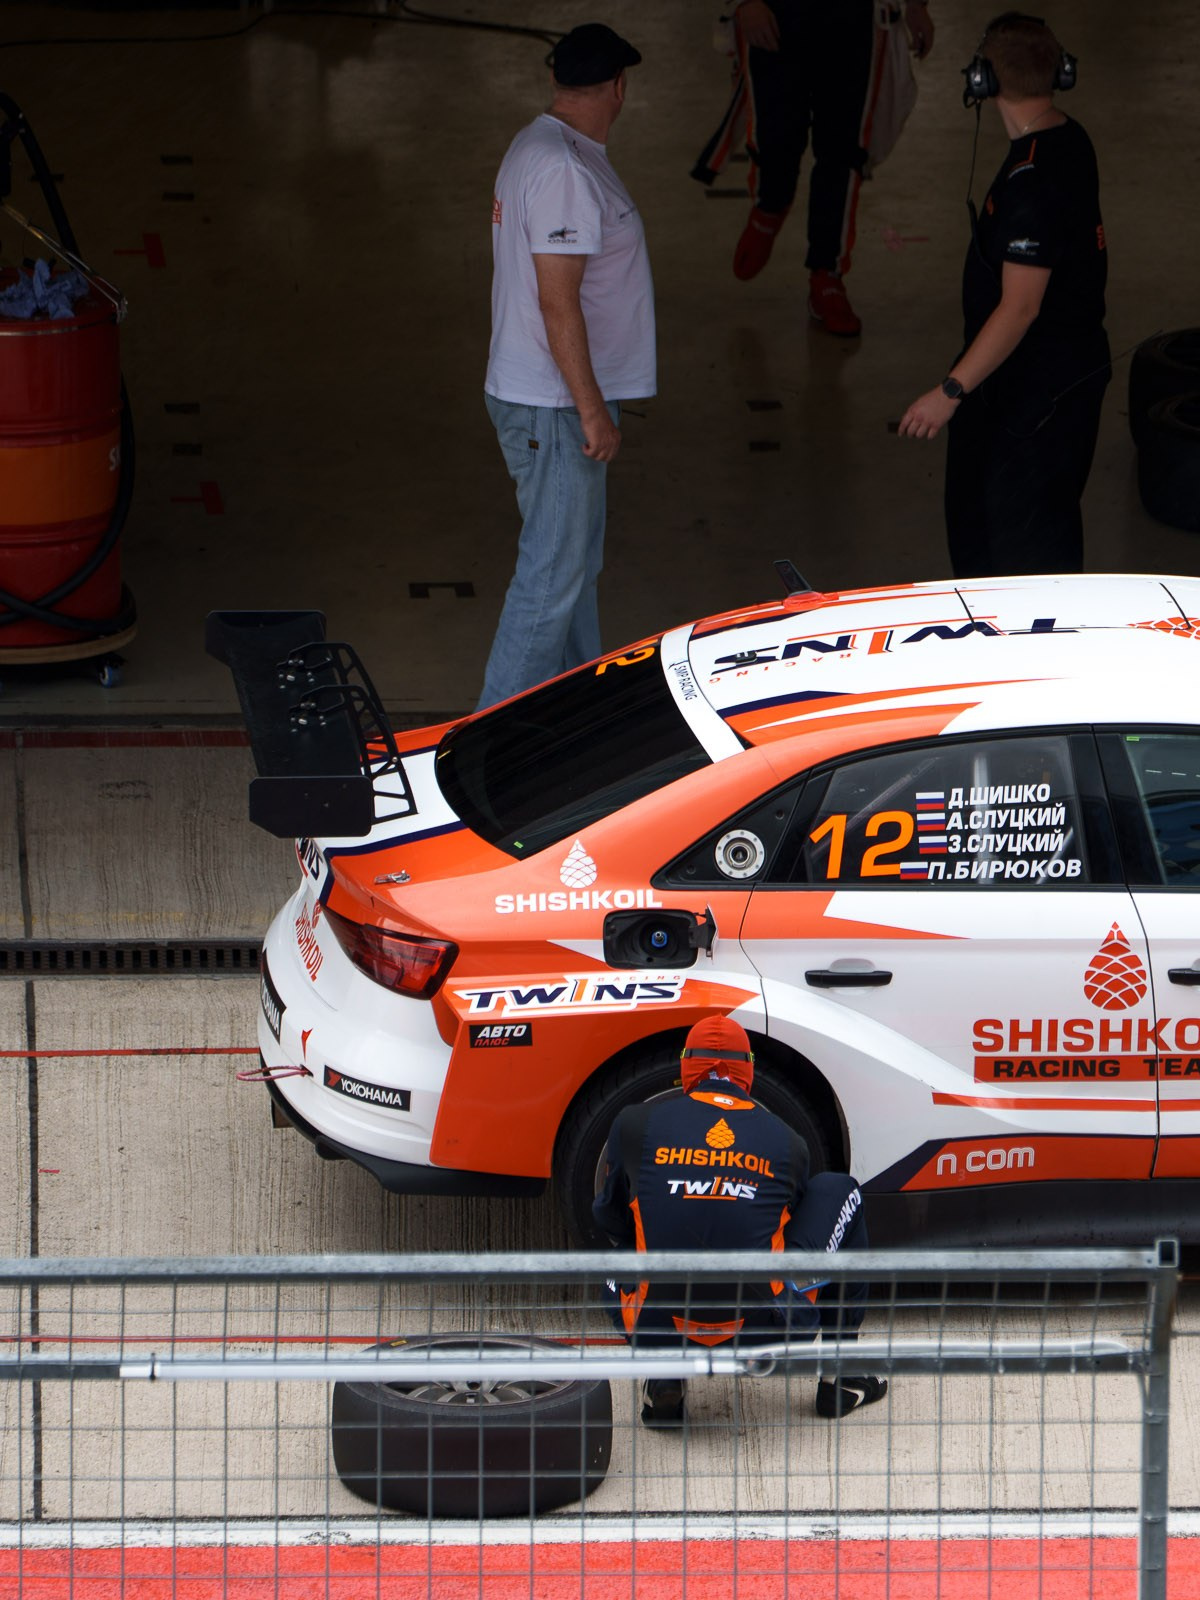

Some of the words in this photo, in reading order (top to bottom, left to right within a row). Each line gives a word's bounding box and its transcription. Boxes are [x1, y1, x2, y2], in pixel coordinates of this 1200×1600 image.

[947, 783, 1051, 809] Д.ШИШКО
[946, 802, 1066, 831] А.СЛУЦКИЙ
[808, 810, 915, 880] 12
[947, 829, 1065, 856] З.СЛУЦКИЙ
[927, 859, 1083, 880] П.БИРЮКОВ
[494, 889, 663, 914] SHISHKOIL
[477, 1025, 527, 1039] АВТО
[993, 1059, 1121, 1078] RACING
[340, 1078, 403, 1107] YOKOHAMA
[654, 1147, 775, 1178] SHISHKOIL
